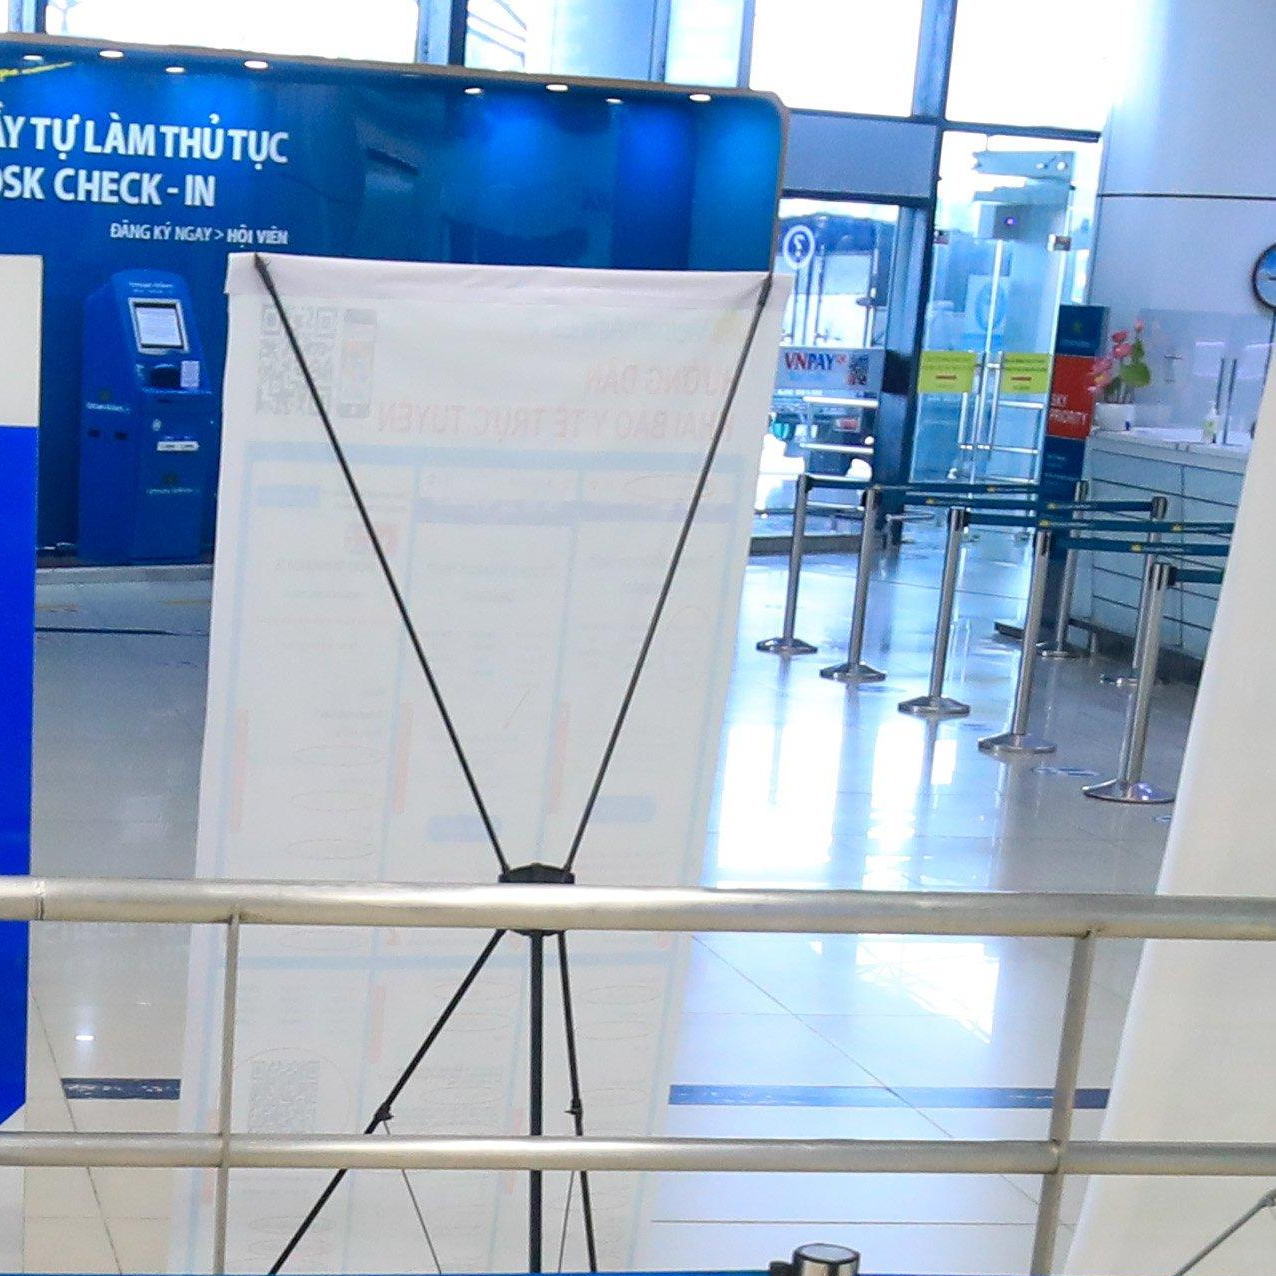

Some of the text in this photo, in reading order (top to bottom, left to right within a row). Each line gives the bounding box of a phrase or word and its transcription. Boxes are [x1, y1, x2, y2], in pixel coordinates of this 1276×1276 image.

[30, 113, 81, 161] TỰ
[84, 111, 156, 157] LÀM
[160, 112, 224, 161] THỦ
[228, 128, 289, 171] TỤC
[53, 167, 163, 206] CHECK
[184, 173, 216, 207] IN
[174, 225, 213, 241] NGAY
[784, 351, 834, 371] VNPAY
